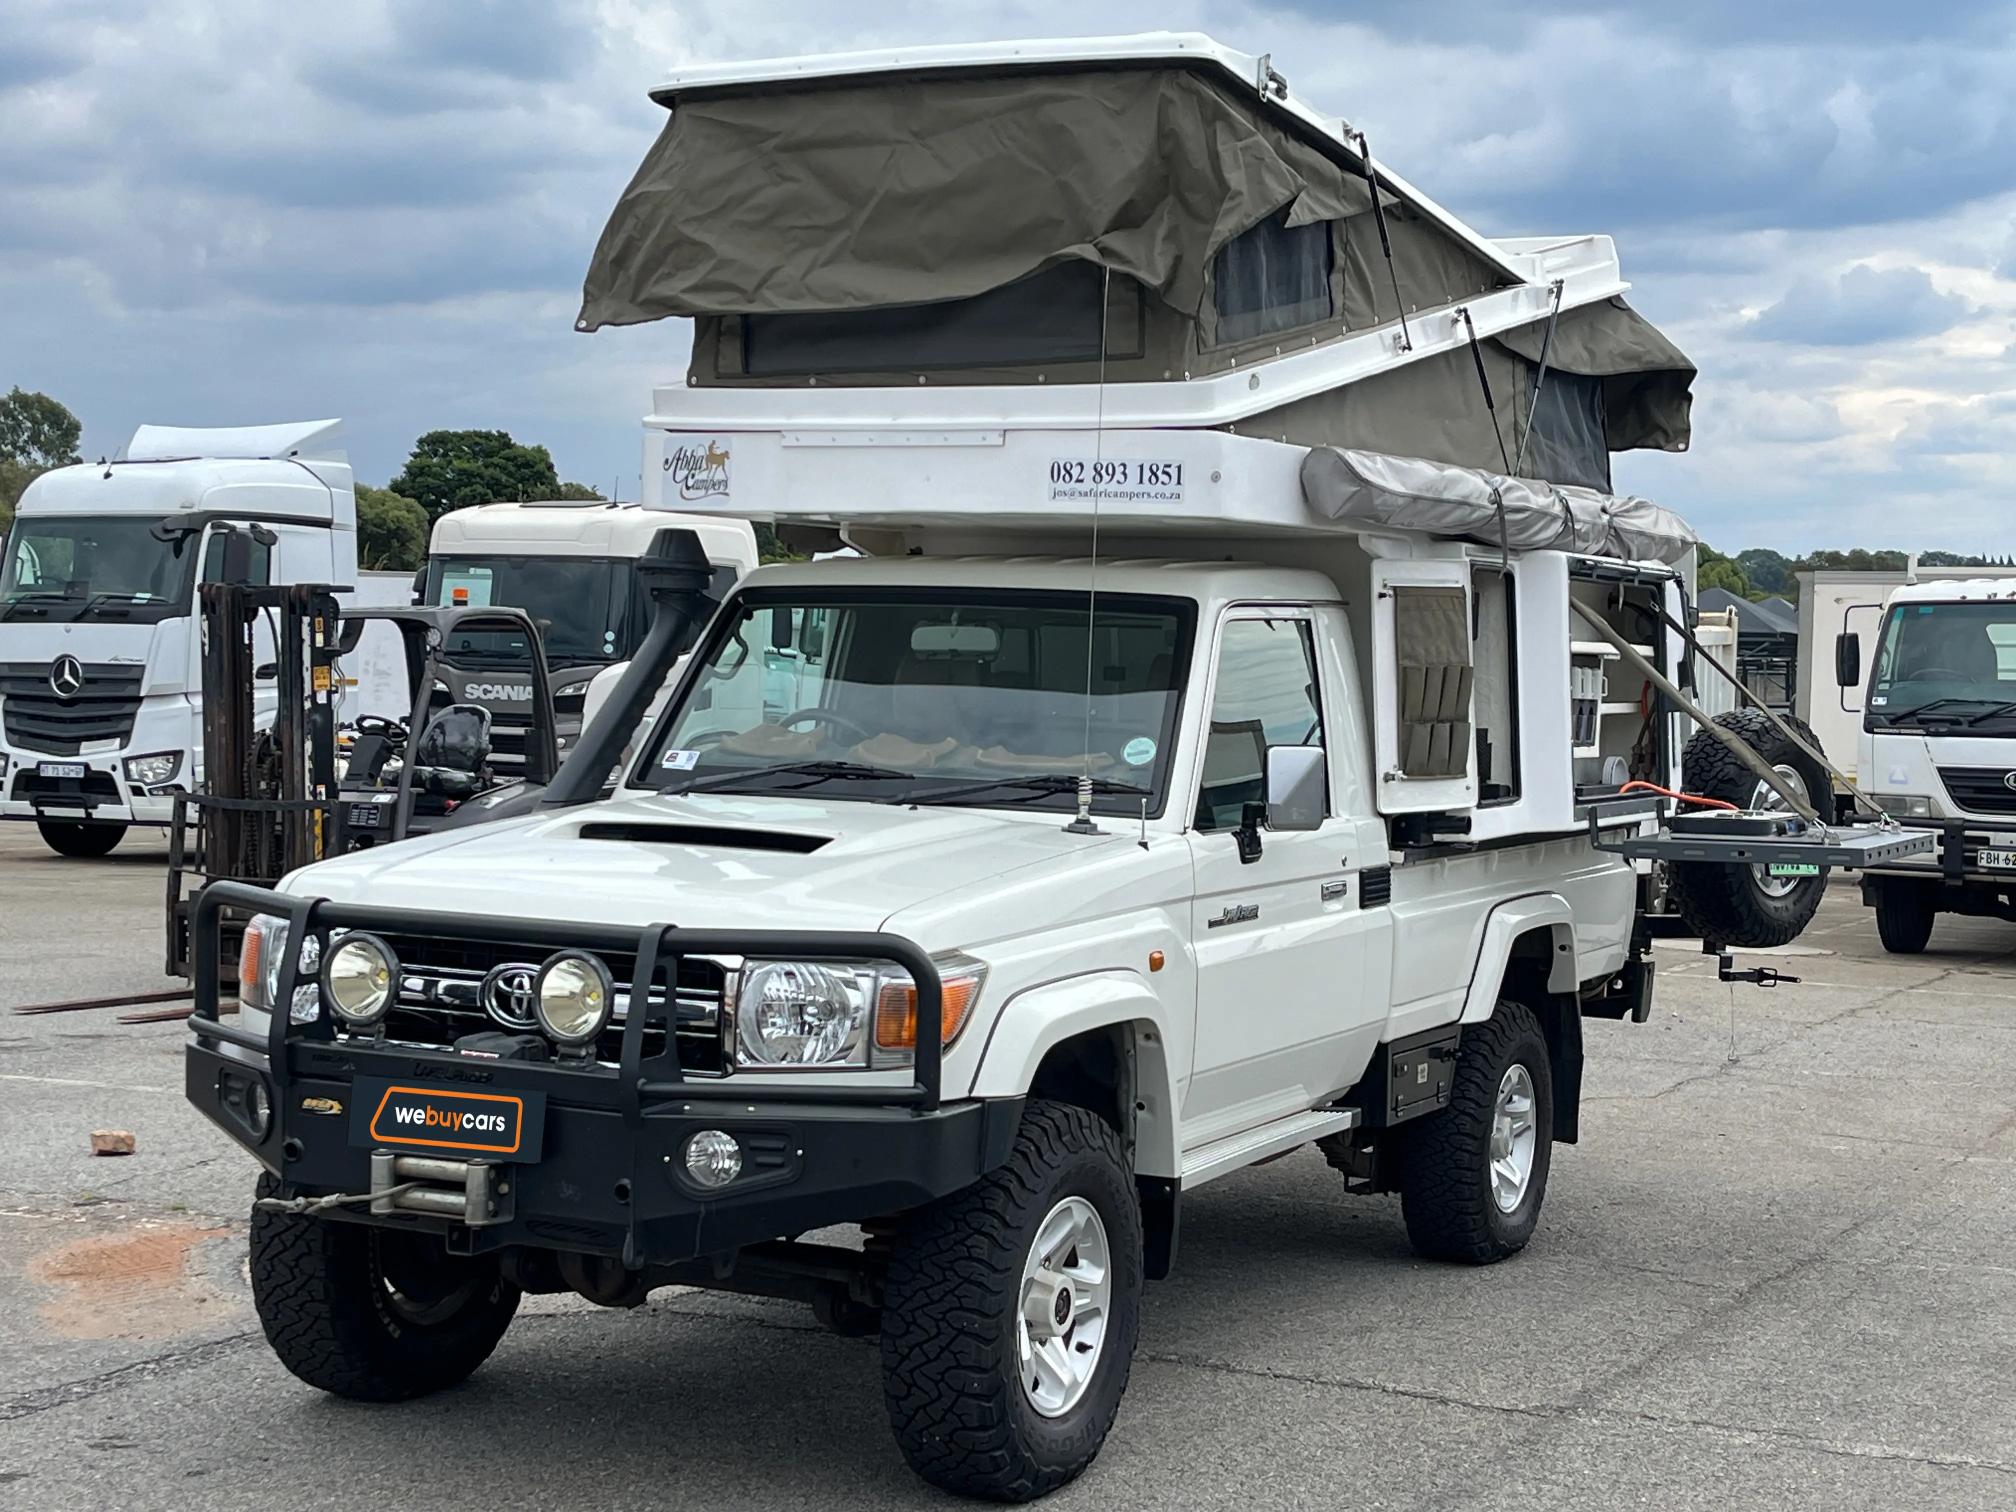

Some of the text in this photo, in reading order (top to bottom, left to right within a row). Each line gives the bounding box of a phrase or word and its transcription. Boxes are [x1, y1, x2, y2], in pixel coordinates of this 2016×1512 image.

[1050, 461, 1183, 486] 082 893 1851
[1052, 487, 1181, 500] jos@safaricampers.co.za
[464, 683, 533, 700] SCANIA
[1980, 852, 2000, 865] FBH
